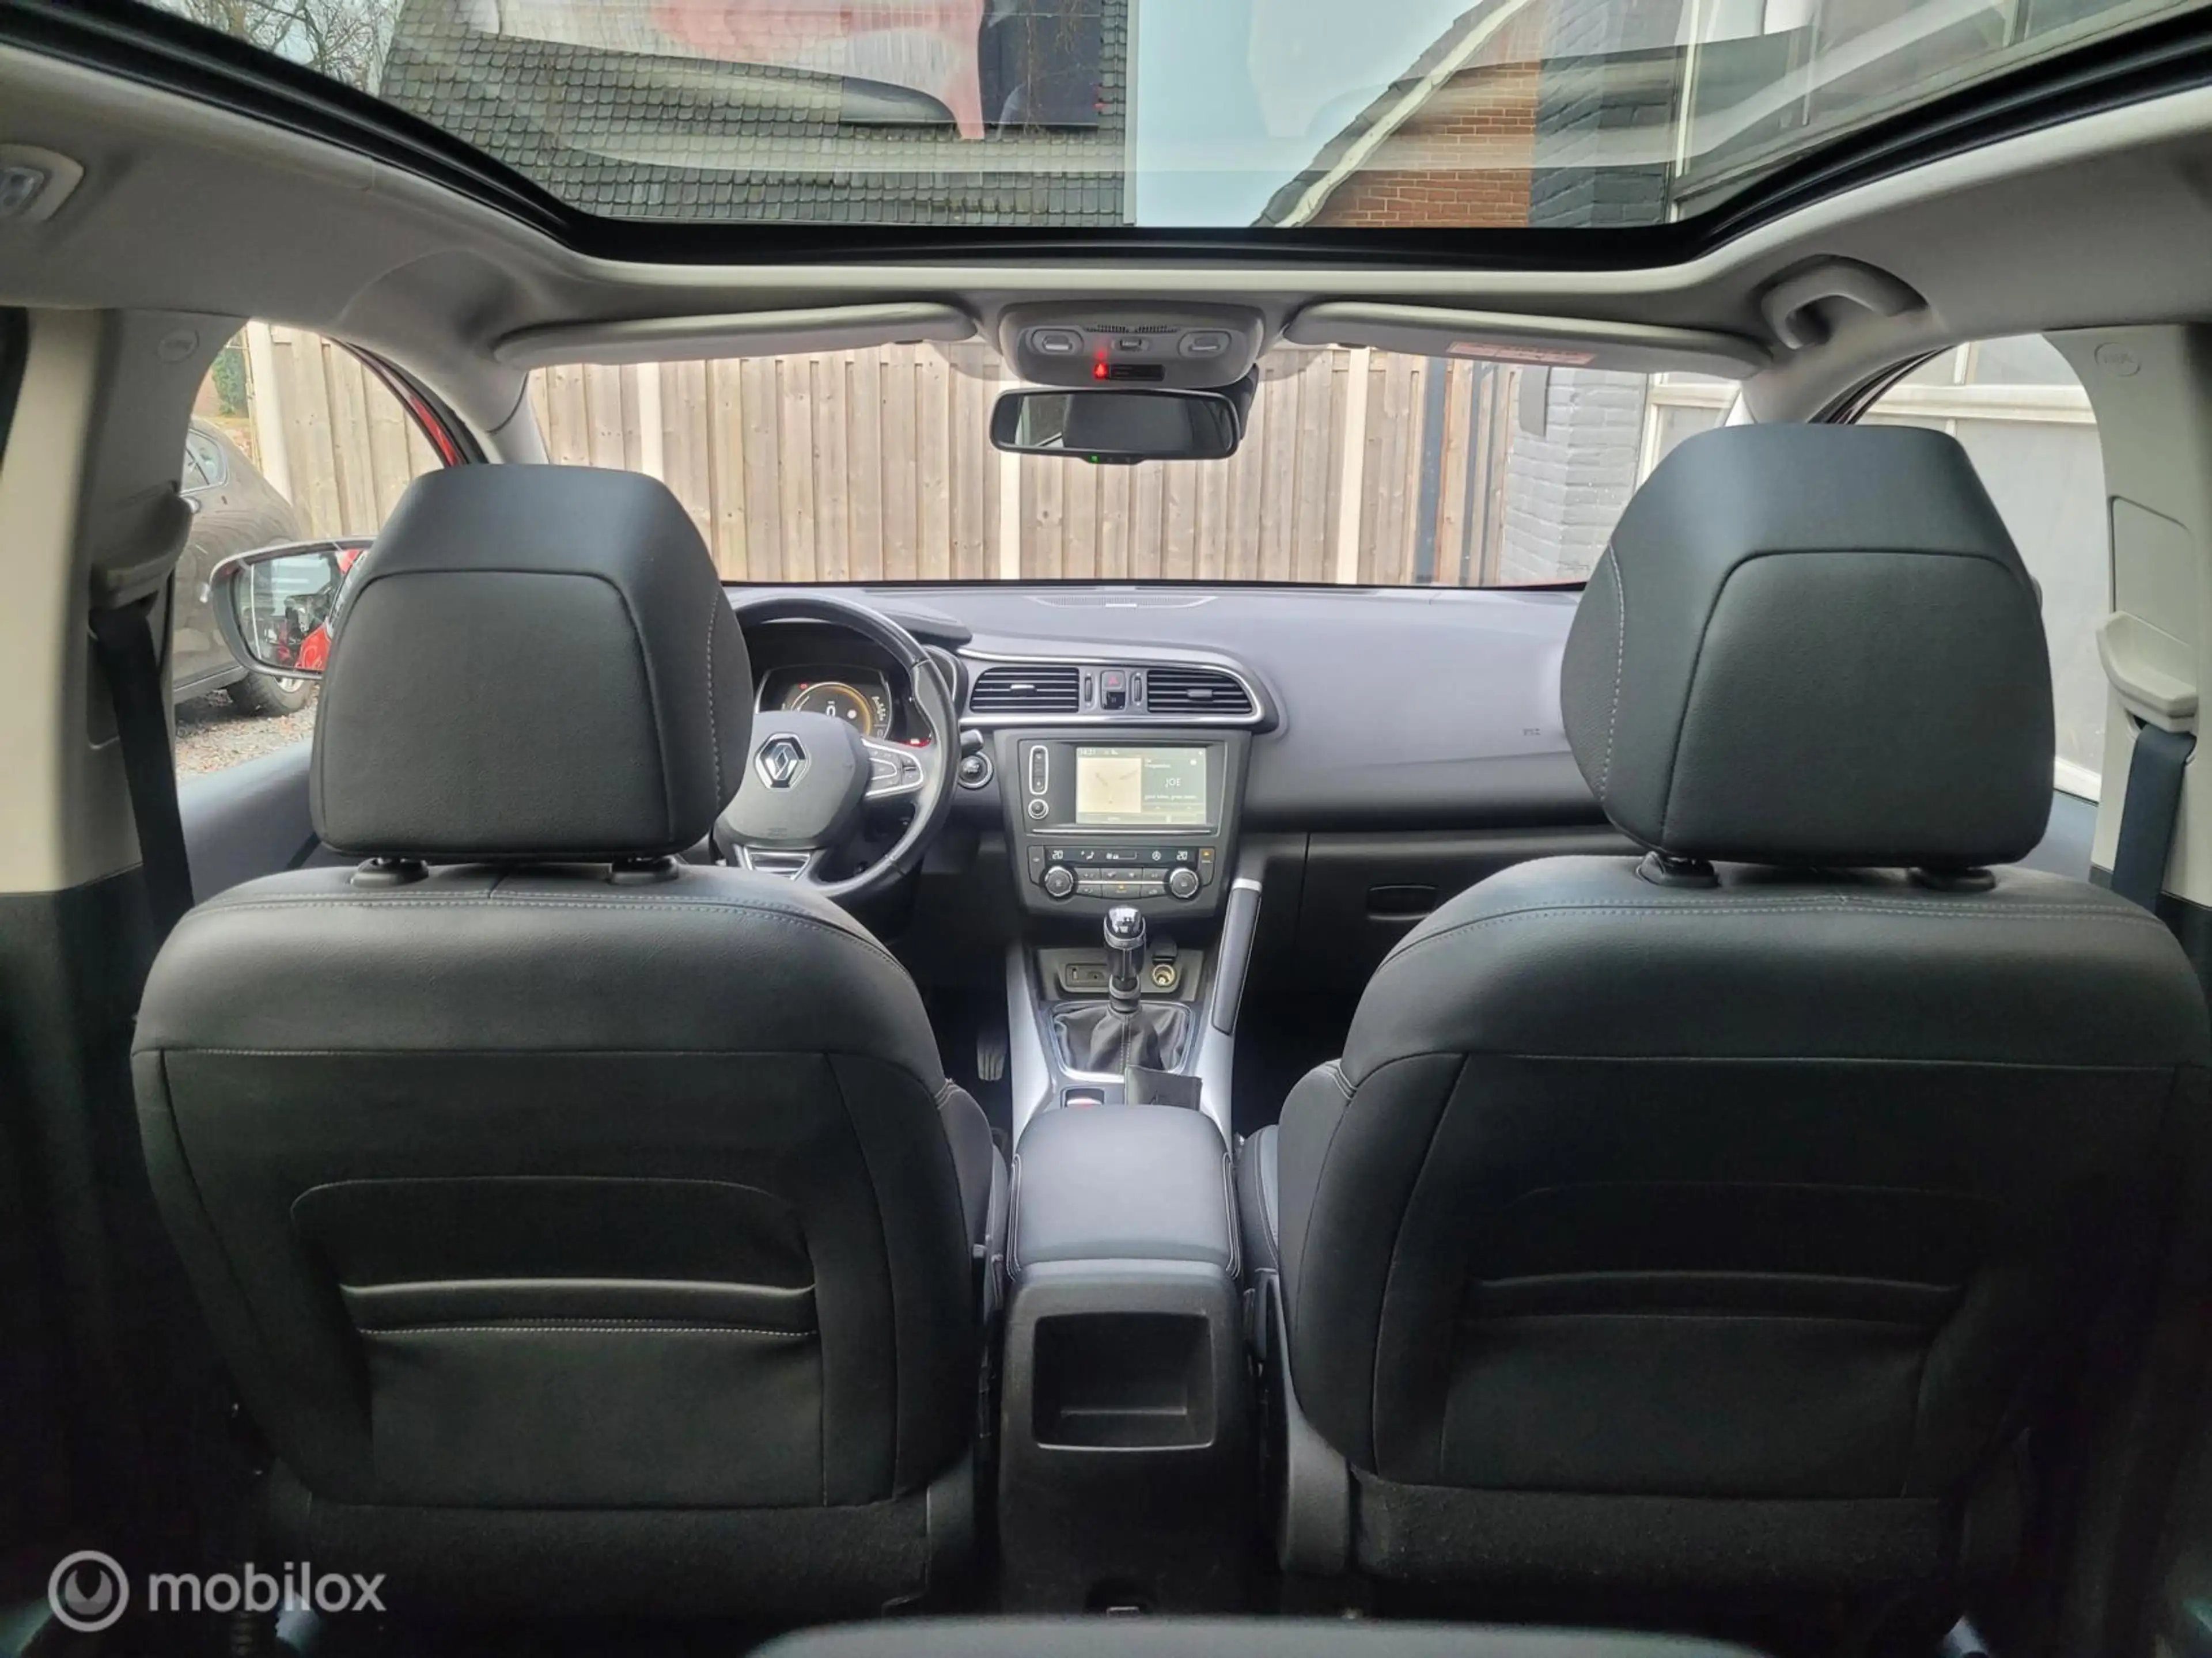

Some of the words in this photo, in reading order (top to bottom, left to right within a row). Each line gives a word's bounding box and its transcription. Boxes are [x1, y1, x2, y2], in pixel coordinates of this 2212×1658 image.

[1165, 777, 1181, 788] JOE
[1052, 850, 1063, 860] 20
[1176, 850, 1188, 860] 20
